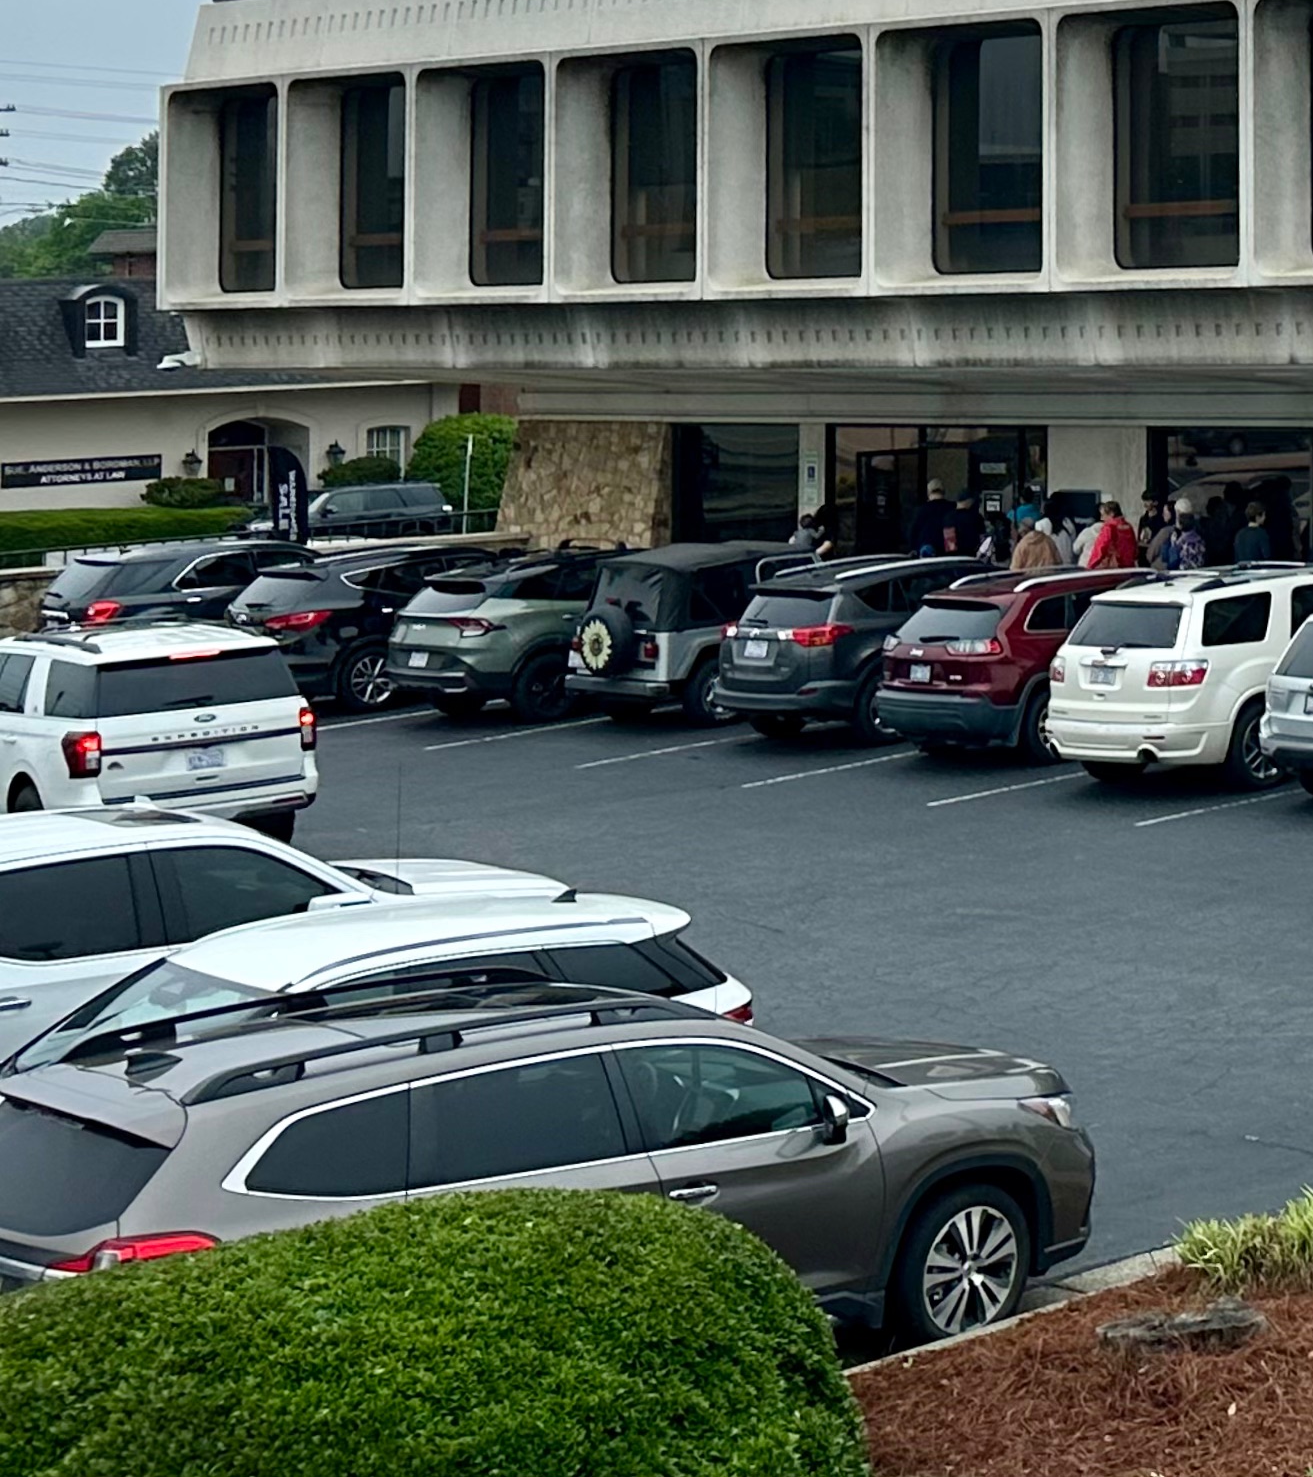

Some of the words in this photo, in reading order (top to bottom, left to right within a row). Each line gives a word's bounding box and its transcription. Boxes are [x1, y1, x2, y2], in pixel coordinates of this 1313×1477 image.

[29, 462, 81, 473] ANDERSON
[40, 472, 92, 484] ATTORNEYS
[93, 472, 103, 481] AT
[106, 470, 126, 480] LAW
[278, 483, 290, 530] SALE
[151, 725, 259, 741] EXPEDITION
